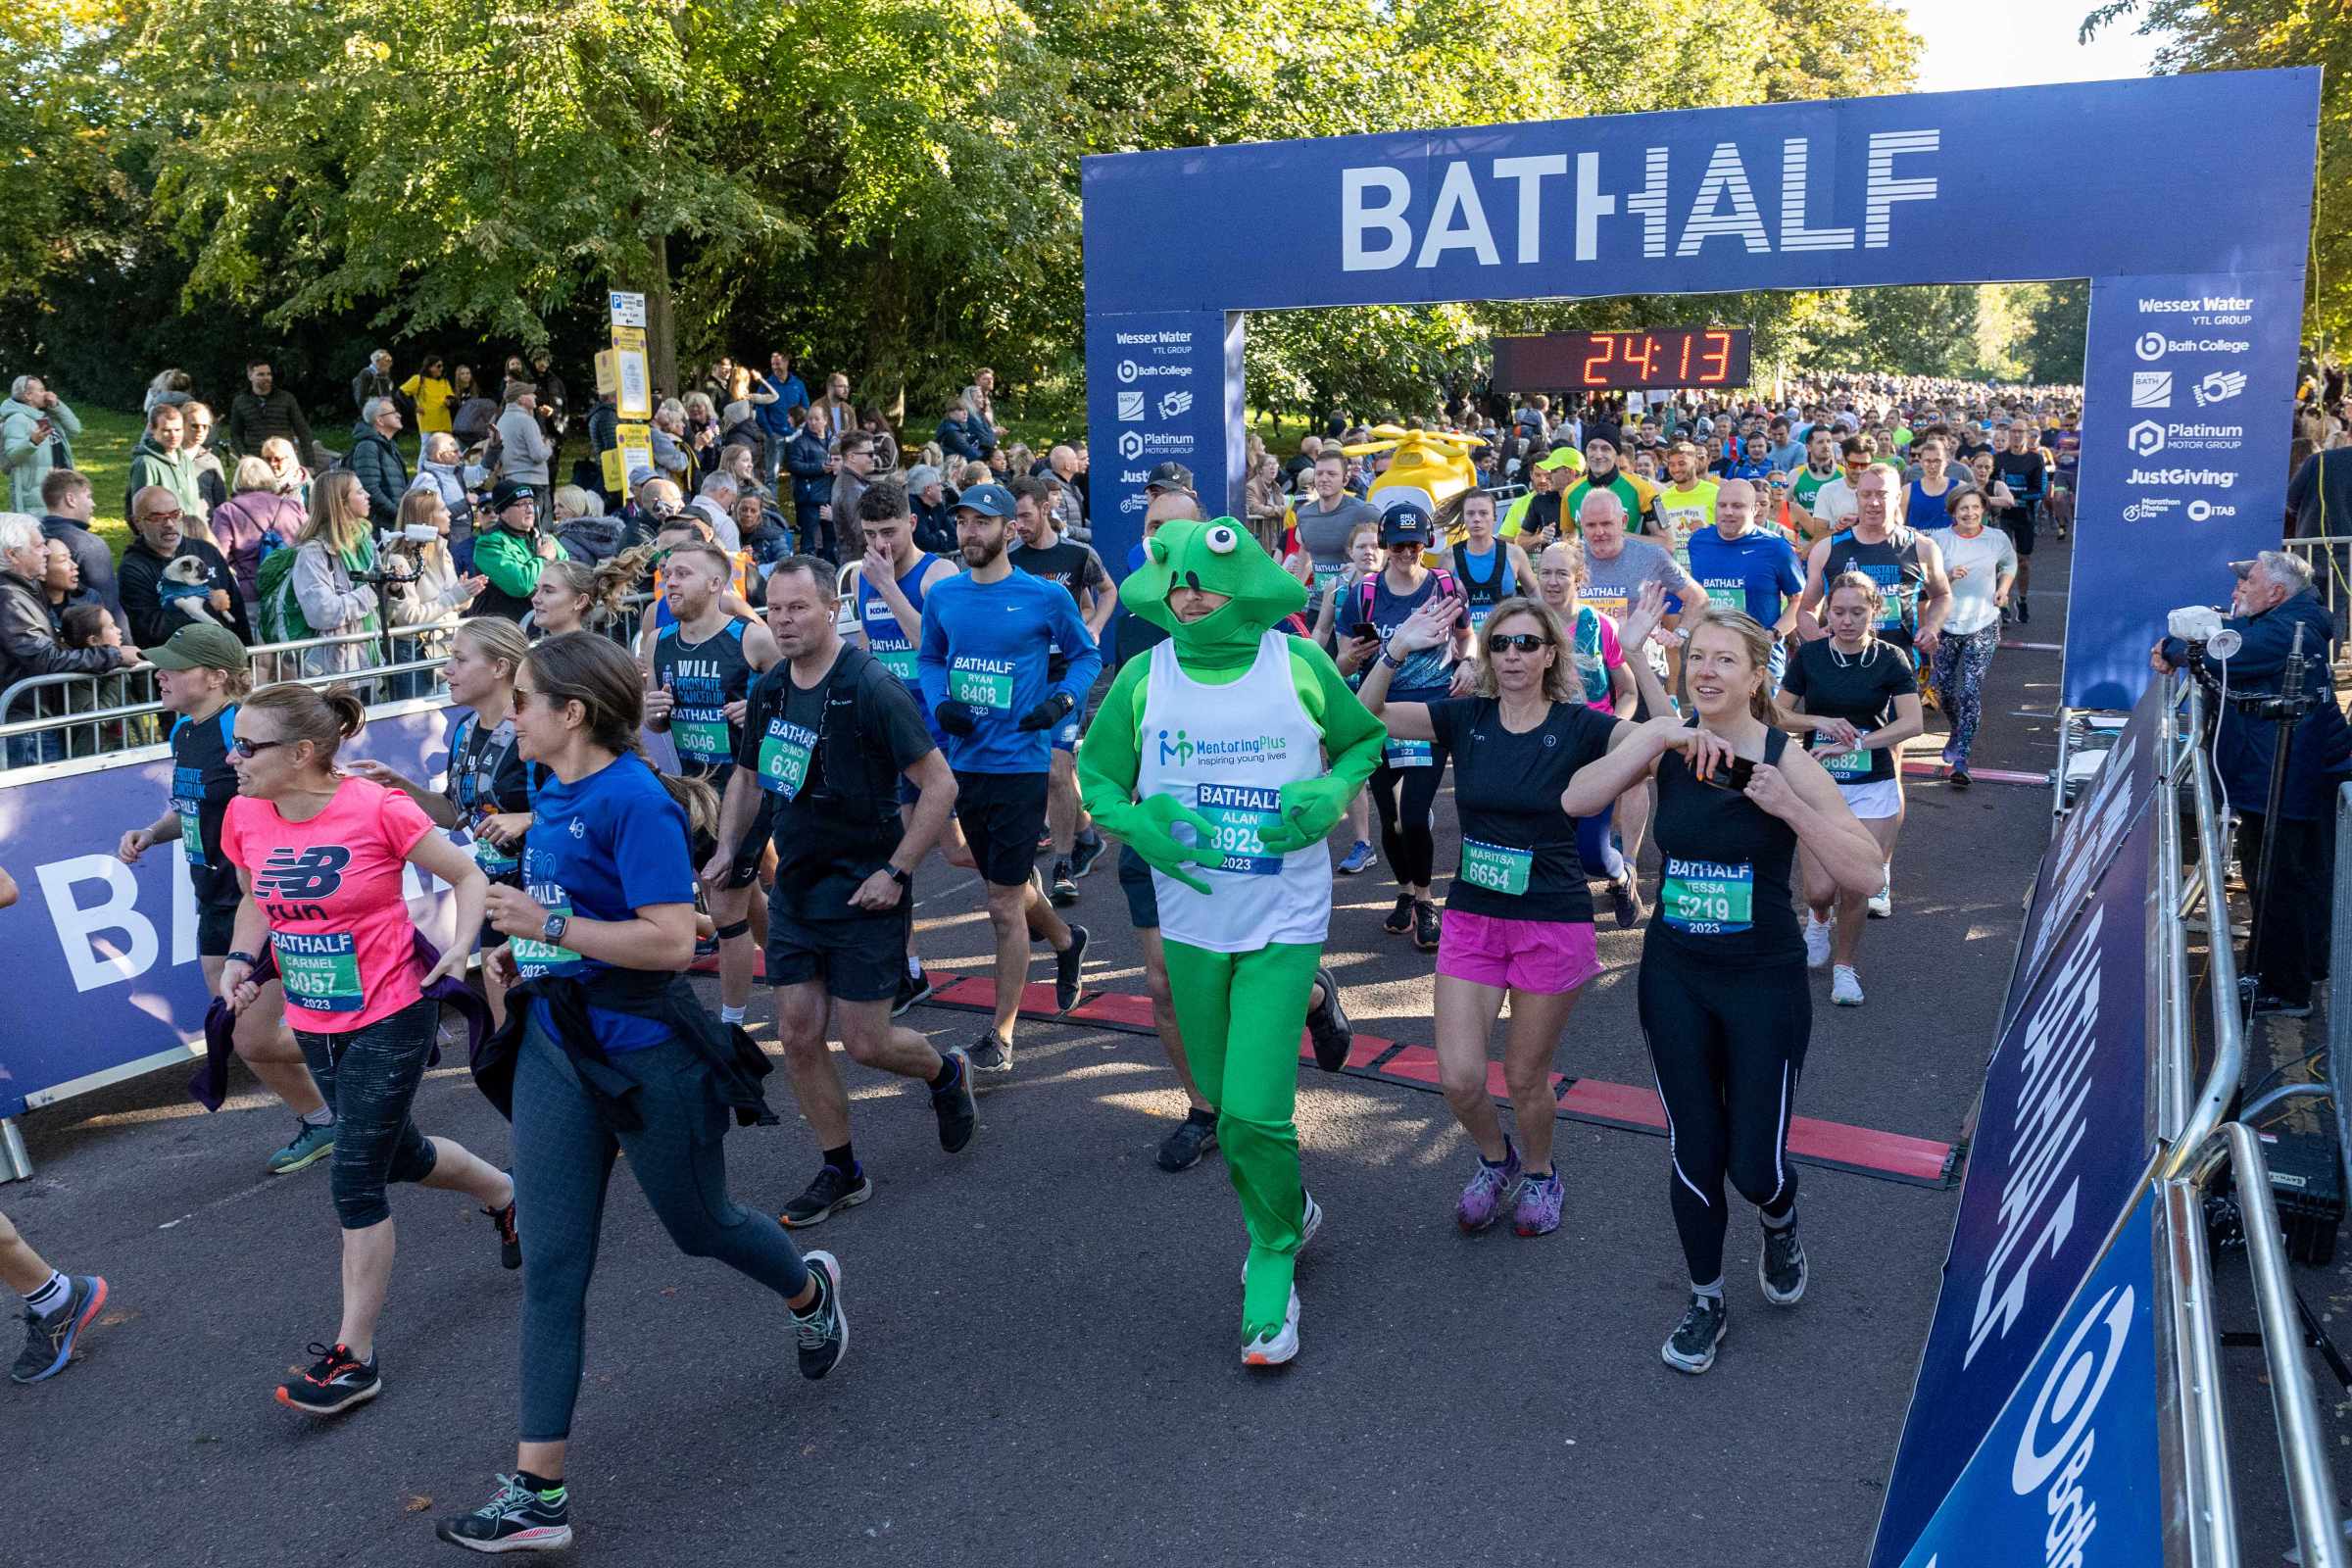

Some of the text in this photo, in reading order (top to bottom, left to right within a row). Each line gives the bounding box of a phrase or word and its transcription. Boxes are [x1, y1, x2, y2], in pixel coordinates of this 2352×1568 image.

[1342, 128, 1939, 271] BATHALF
[2138, 297, 2254, 313] Wessex Water
[2215, 316, 2252, 324] GROUP
[1116, 331, 1193, 344] Wessex Water
[2168, 339, 2250, 353] Bath College
[1584, 332, 1733, 383] 24:13
[1138, 366, 1193, 376] Bath College
[2168, 423, 2243, 437] Platinum
[1145, 433, 1194, 444] Platinum
[2126, 468, 2234, 488] JustGiving
[2211, 506, 2235, 516] ITAB
[1703, 578, 1744, 588] BATHALF
[1579, 587, 1627, 597] BATHALF
[677, 660, 721, 678] WILL
[954, 657, 1016, 674] BATHALF
[676, 677, 721, 690] PROSTATE
[968, 673, 994, 684] RYAN
[678, 691, 713, 705] CANCER
[960, 683, 997, 704] 8408
[670, 709, 725, 722] BATHALF
[970, 705, 989, 715] 2023
[682, 733, 715, 752] 5046
[1197, 735, 1287, 756] MentoringPlus
[1198, 751, 1287, 767] Inspiring young lives
[1222, 811, 1258, 824] ALAN
[1210, 825, 1264, 854] 3925
[1221, 857, 1251, 870] 2023
[1470, 848, 1515, 865] MARITSA
[1470, 861, 1510, 889] 6654
[1668, 858, 1749, 878] BATHALF
[1685, 882, 1726, 894] TESSA
[267, 903, 329, 921] run
[1677, 894, 1730, 920] 5219
[1688, 922, 1721, 934] 2023
[271, 930, 351, 953] BATHALF
[284, 956, 338, 969] CARMEL
[519, 963, 550, 978] 2023
[301, 996, 331, 1010] 2023
